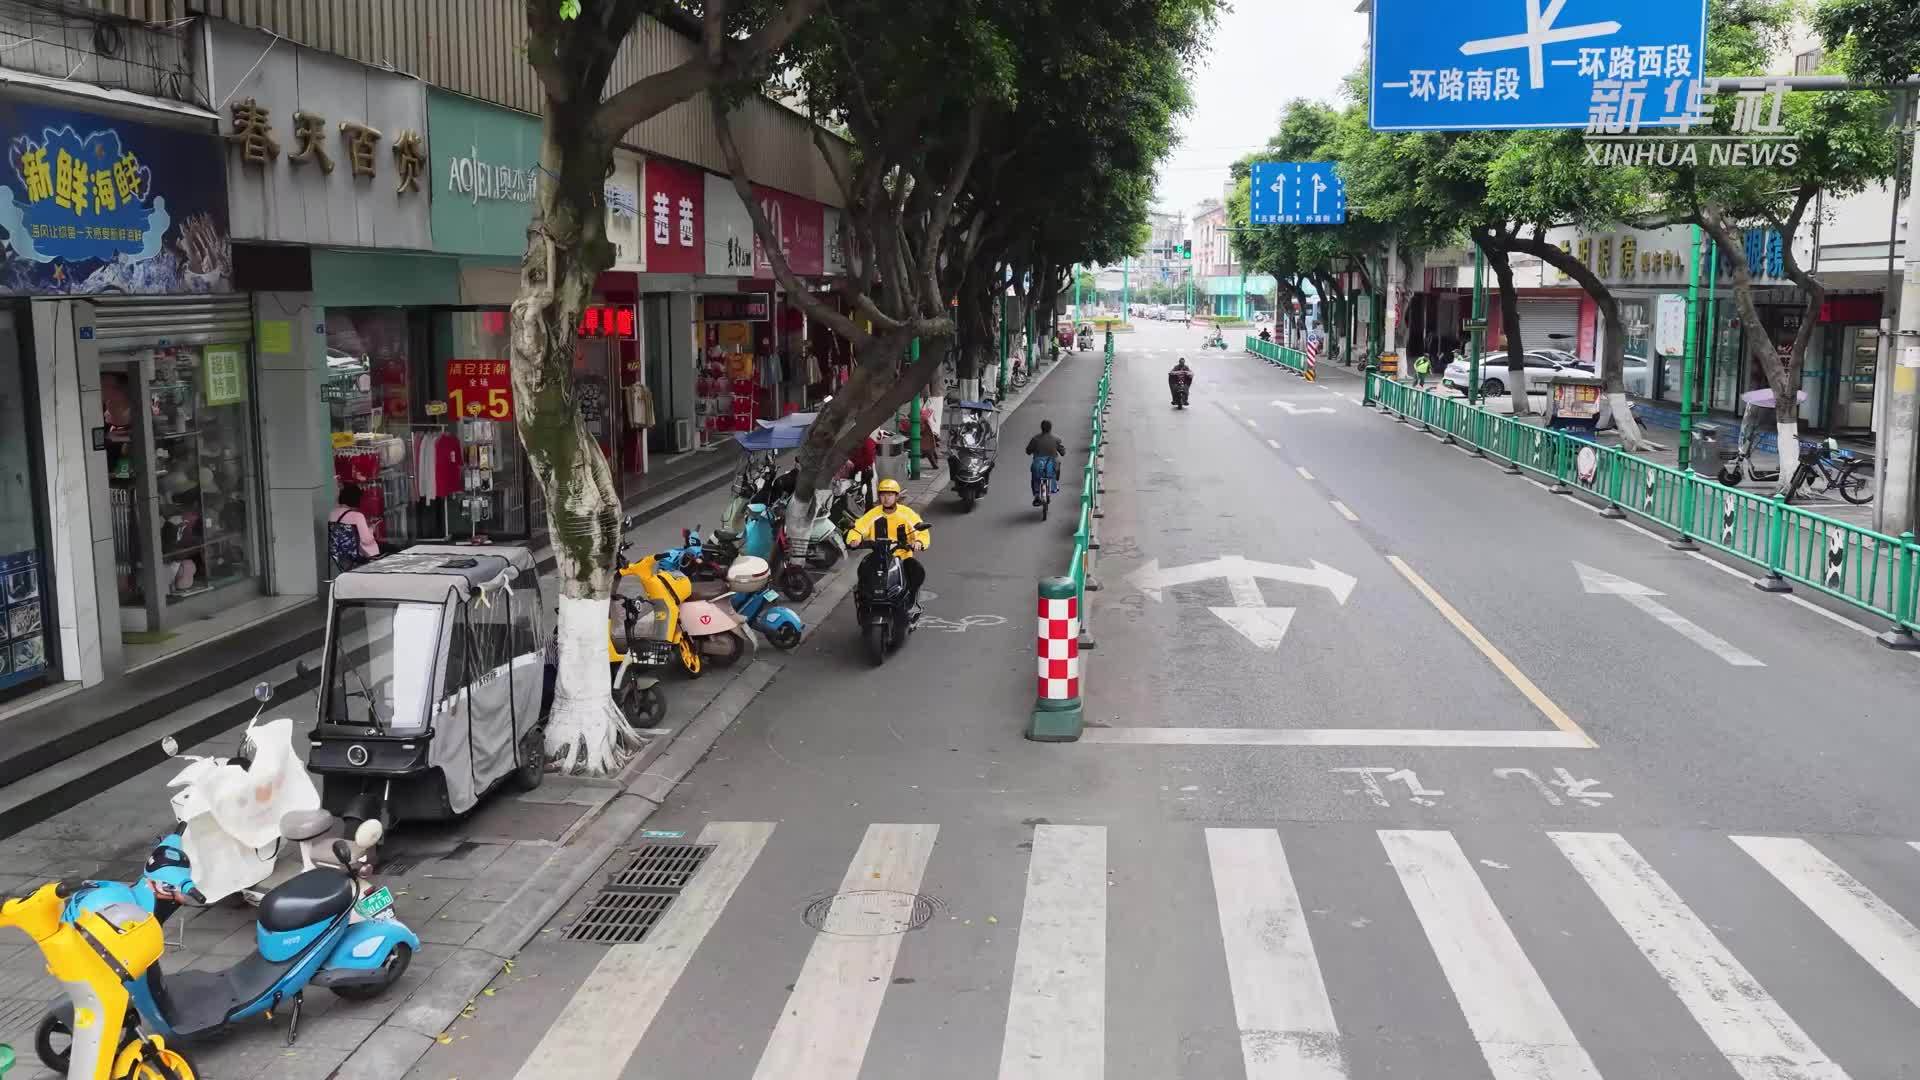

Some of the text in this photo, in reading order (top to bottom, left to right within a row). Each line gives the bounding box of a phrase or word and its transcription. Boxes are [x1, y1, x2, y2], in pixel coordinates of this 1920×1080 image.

[1382, 67, 1521, 102] 一环路南段
[1551, 44, 1692, 81] 一环路西段
[226, 96, 427, 193] 春天百货
[22, 147, 142, 216] 新鲜海鲜
